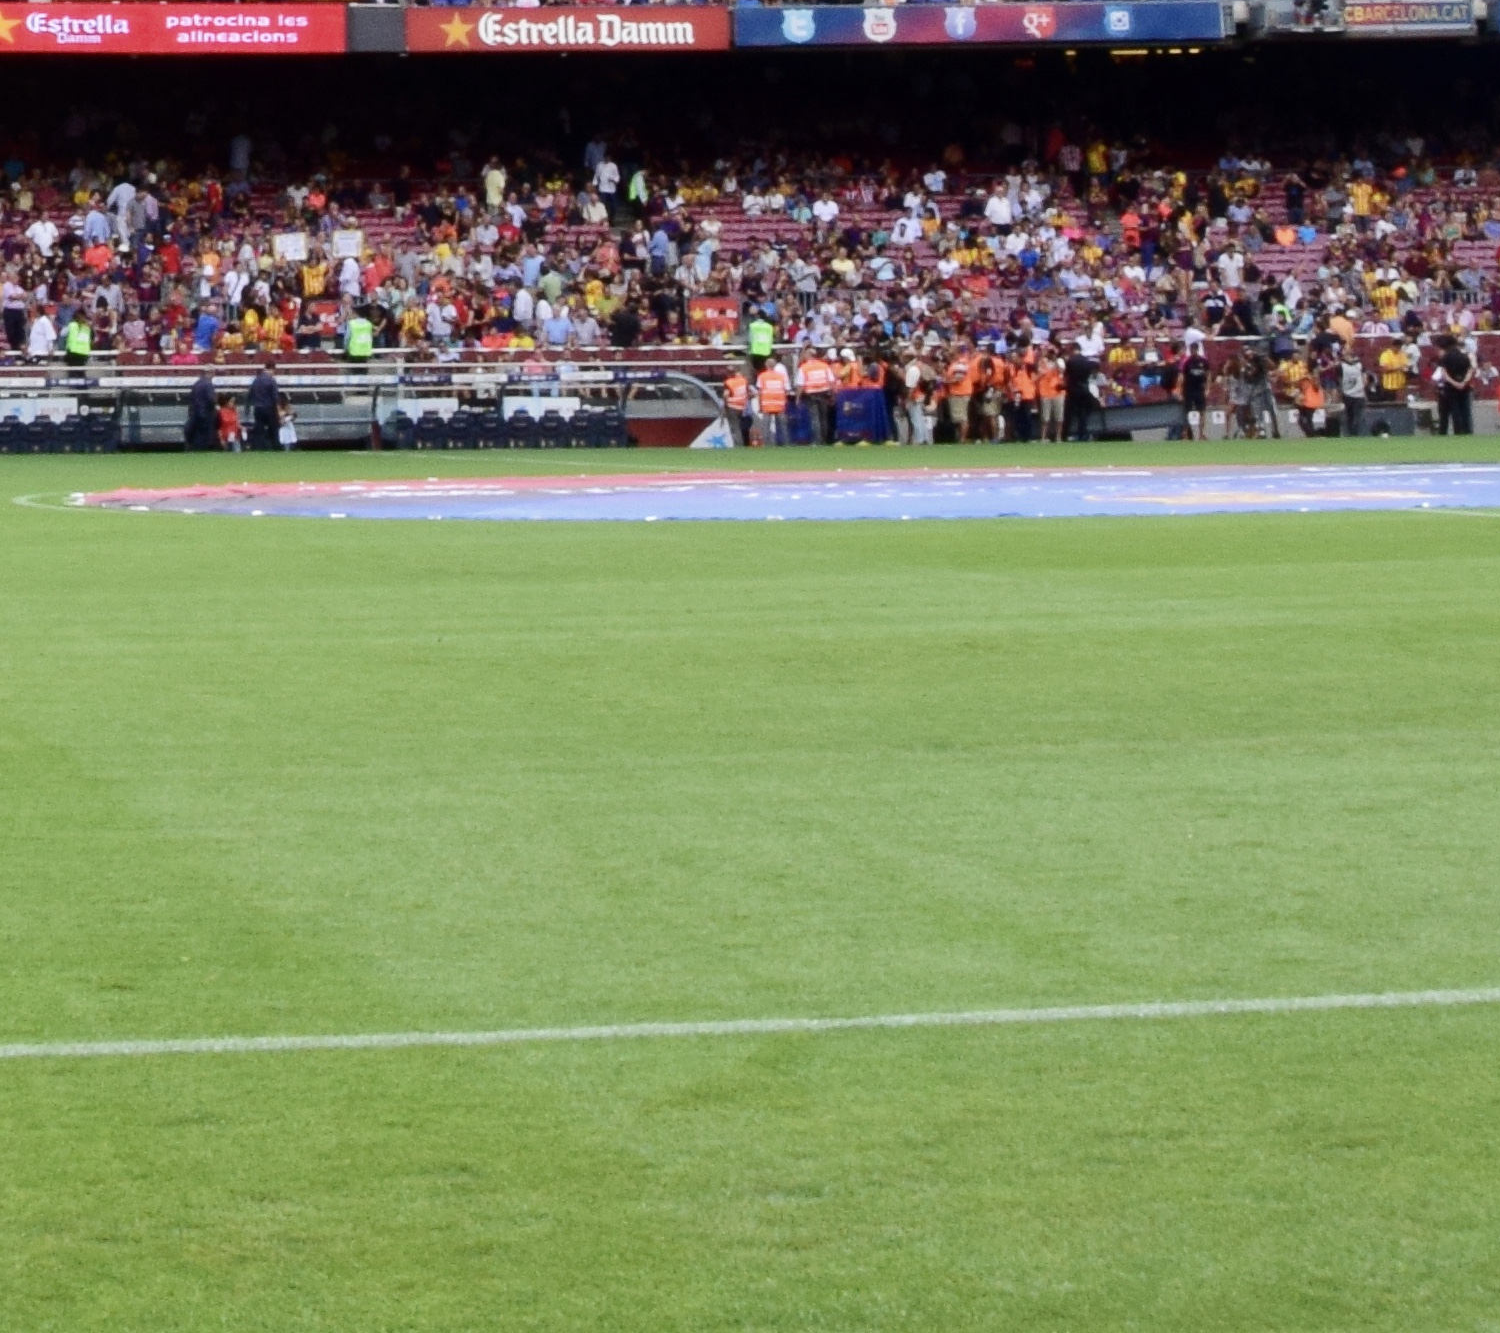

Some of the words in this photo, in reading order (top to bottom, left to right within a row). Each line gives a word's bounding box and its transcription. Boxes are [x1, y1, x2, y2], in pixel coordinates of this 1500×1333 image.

[26, 12, 129, 35] Estrella
[166, 14, 270, 30] patrocina
[478, 11, 595, 46] Estrella
[596, 14, 694, 47] Damm
[177, 30, 299, 44] alineacions
